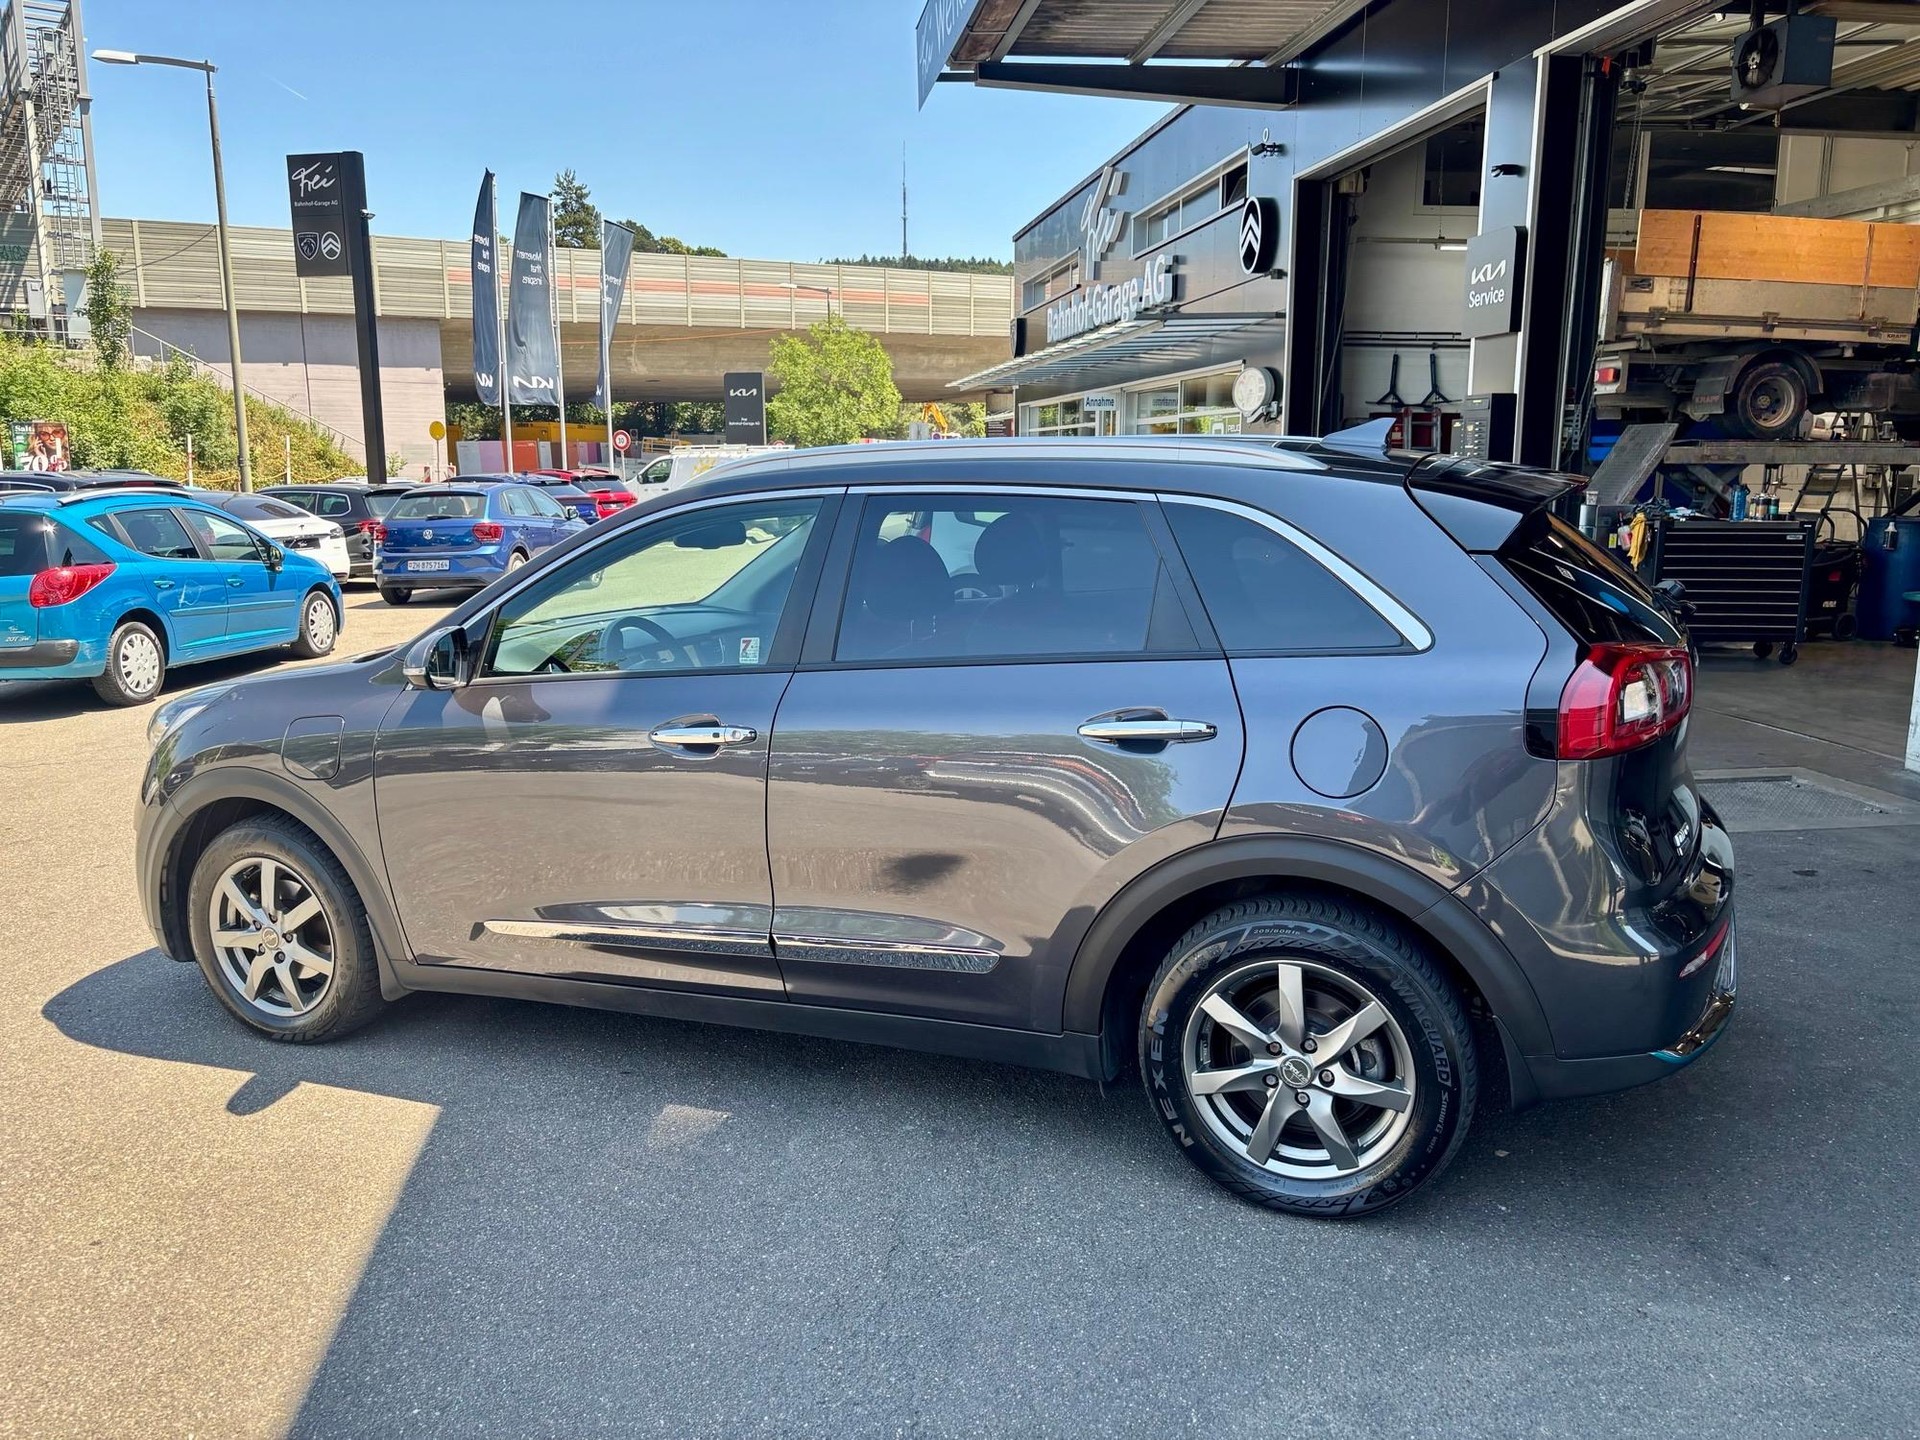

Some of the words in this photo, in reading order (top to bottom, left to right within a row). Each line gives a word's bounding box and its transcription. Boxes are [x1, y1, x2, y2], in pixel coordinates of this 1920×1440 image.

[1047, 277, 1140, 343] Bahnhof-Garage
[1142, 254, 1170, 308] AG
[1469, 286, 1505, 308] Service
[1085, 396, 1115, 407] Annahme
[1147, 1008, 1195, 1148] NEXEN
